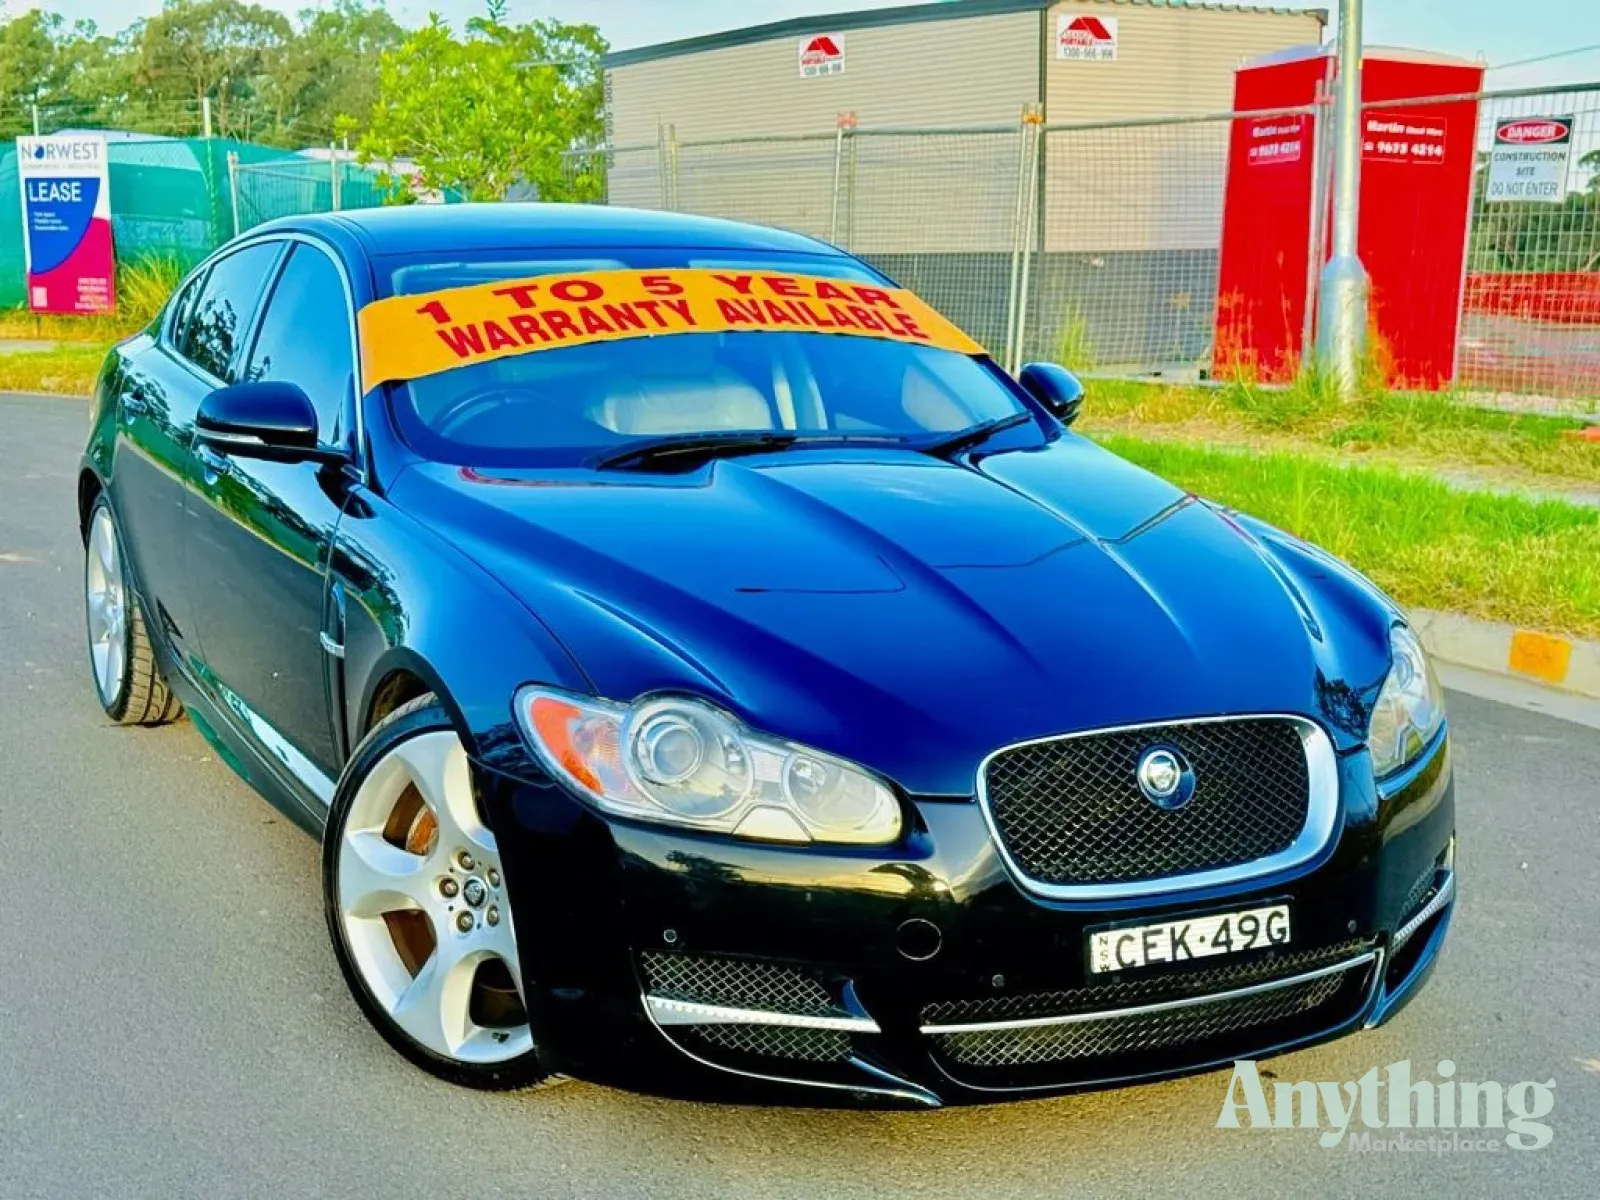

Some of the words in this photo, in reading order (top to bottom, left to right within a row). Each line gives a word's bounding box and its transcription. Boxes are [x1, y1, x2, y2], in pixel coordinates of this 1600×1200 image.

[1507, 125, 1556, 138] DANGER
[1493, 151, 1567, 162] CONSTRUCTION
[1516, 166, 1536, 176] SITE
[28, 181, 82, 202] LEASE
[1491, 181, 1503, 196] DO
[1506, 182, 1525, 195] NOT
[1526, 181, 1559, 196] ENTER
[416, 300, 451, 324] 1
[492, 284, 604, 309] TO
[640, 275, 684, 296] 5
[711, 274, 901, 309] YEAR
[436, 299, 697, 358] WARRANTY
[716, 298, 931, 340] AVAILABLE
